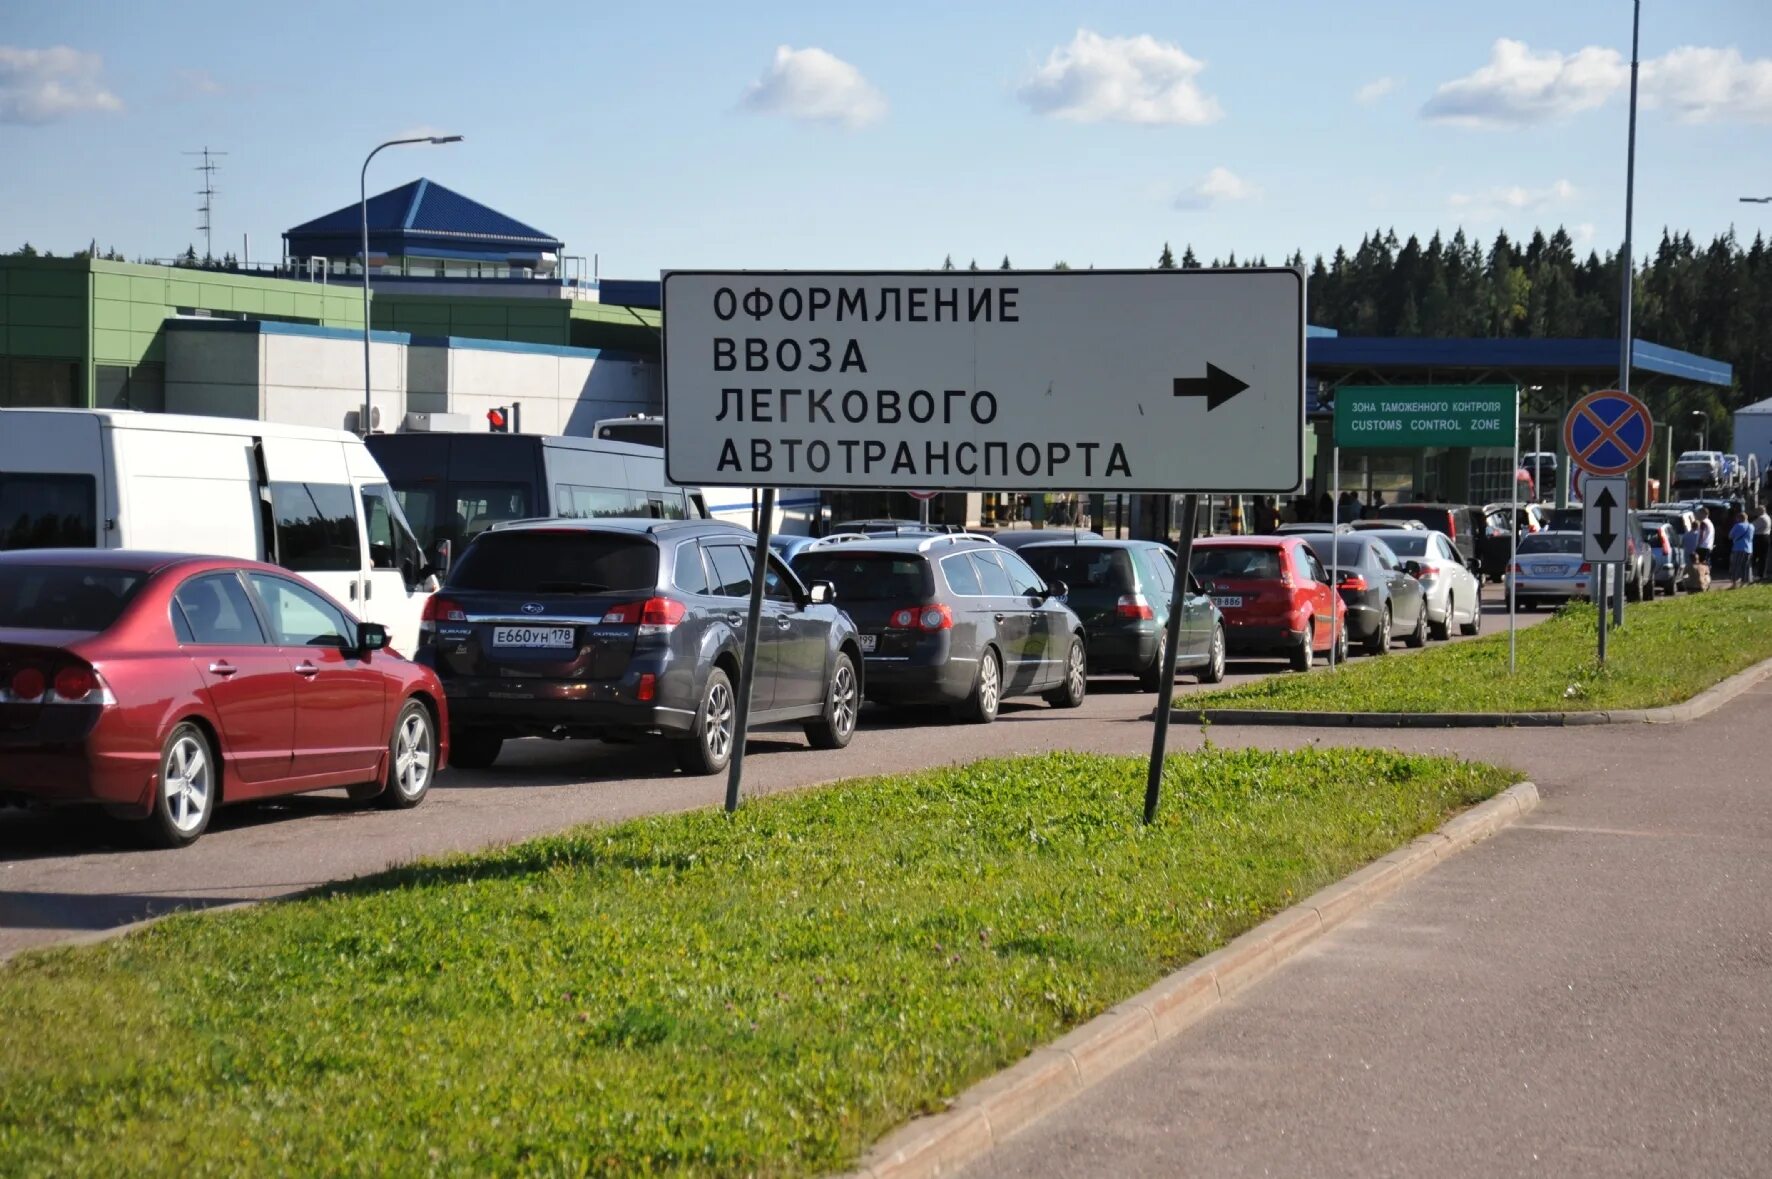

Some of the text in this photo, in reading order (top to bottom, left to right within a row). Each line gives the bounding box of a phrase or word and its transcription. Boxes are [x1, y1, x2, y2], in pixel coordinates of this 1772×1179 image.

[713, 286, 1020, 323] ОФОРМЛЕНИЕ
[713, 337, 868, 374] ВВОЗА
[715, 388, 998, 425] ЛЕГКОВОГО
[1351, 418, 1501, 431] CUSTOMS CONTROL ZONE
[1352, 401, 1501, 412] ЗОНА ТАМОЖЕННОГО КОНТРОЛЯ
[716, 438, 1133, 478] АВТОТРАНСПОРТА
